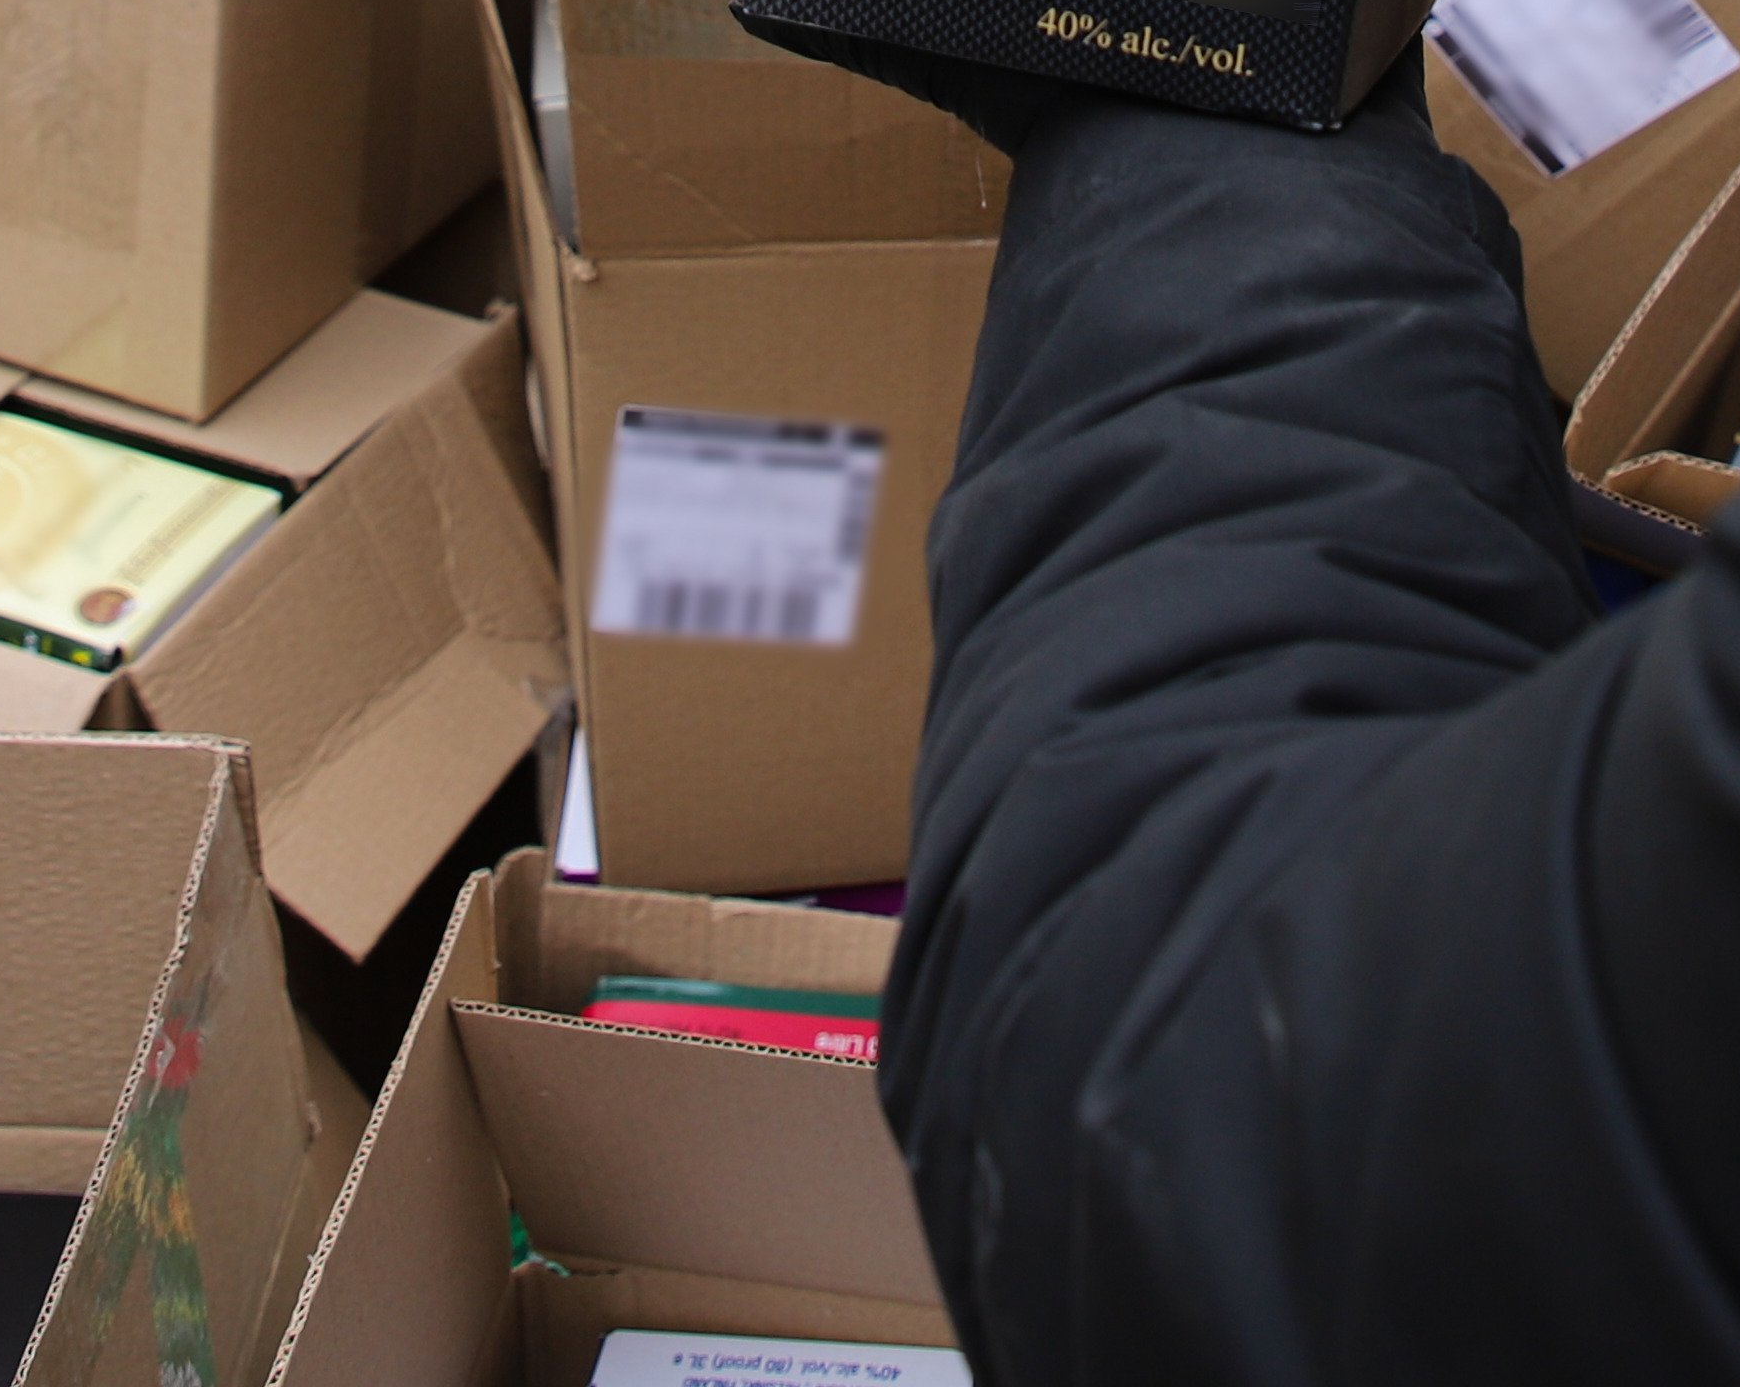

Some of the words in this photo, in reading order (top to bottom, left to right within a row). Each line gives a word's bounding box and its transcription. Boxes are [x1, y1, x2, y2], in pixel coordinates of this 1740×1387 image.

[1036, 7, 1112, 50] 40%
[1121, 26, 1256, 78] alc./vol.
[866, 1363, 901, 1381] 40%
